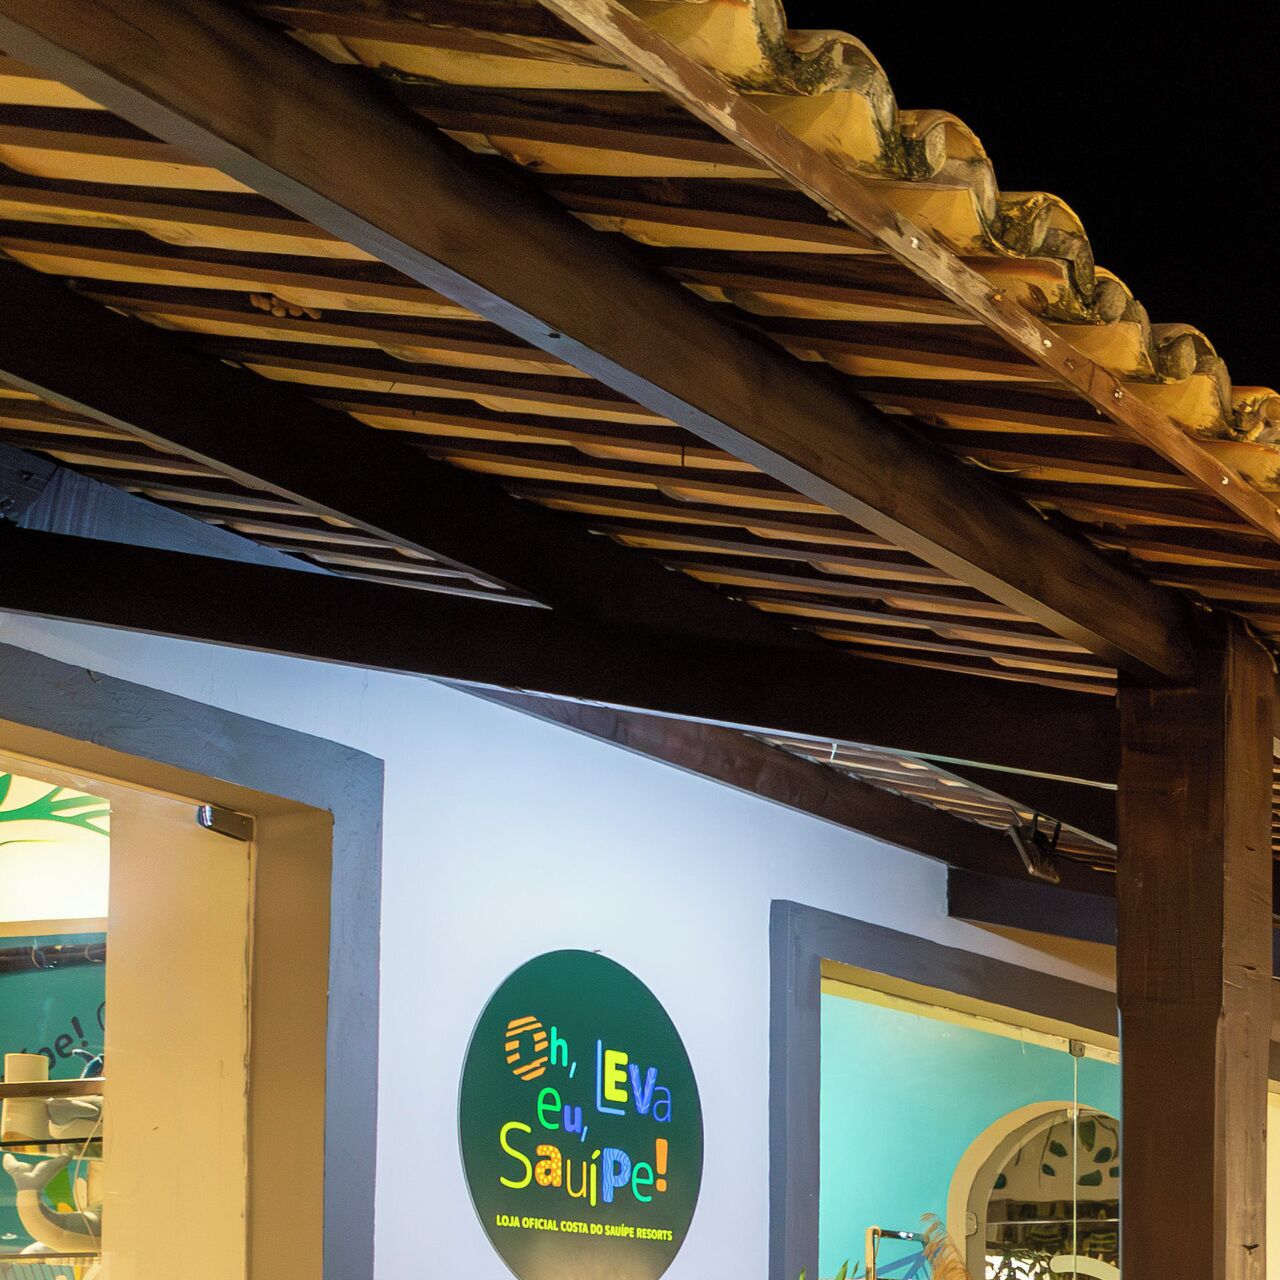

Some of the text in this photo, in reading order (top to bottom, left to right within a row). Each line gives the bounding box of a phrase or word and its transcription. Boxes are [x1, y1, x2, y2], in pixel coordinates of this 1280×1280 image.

[505, 1016, 577, 1081] Oh,
[537, 1087, 588, 1142] eu,
[500, 1121, 668, 1207] Sauípe!
[496, 1214, 673, 1242] LOJA OFICIAL COSTA DO SAUÍPE RESORTS
